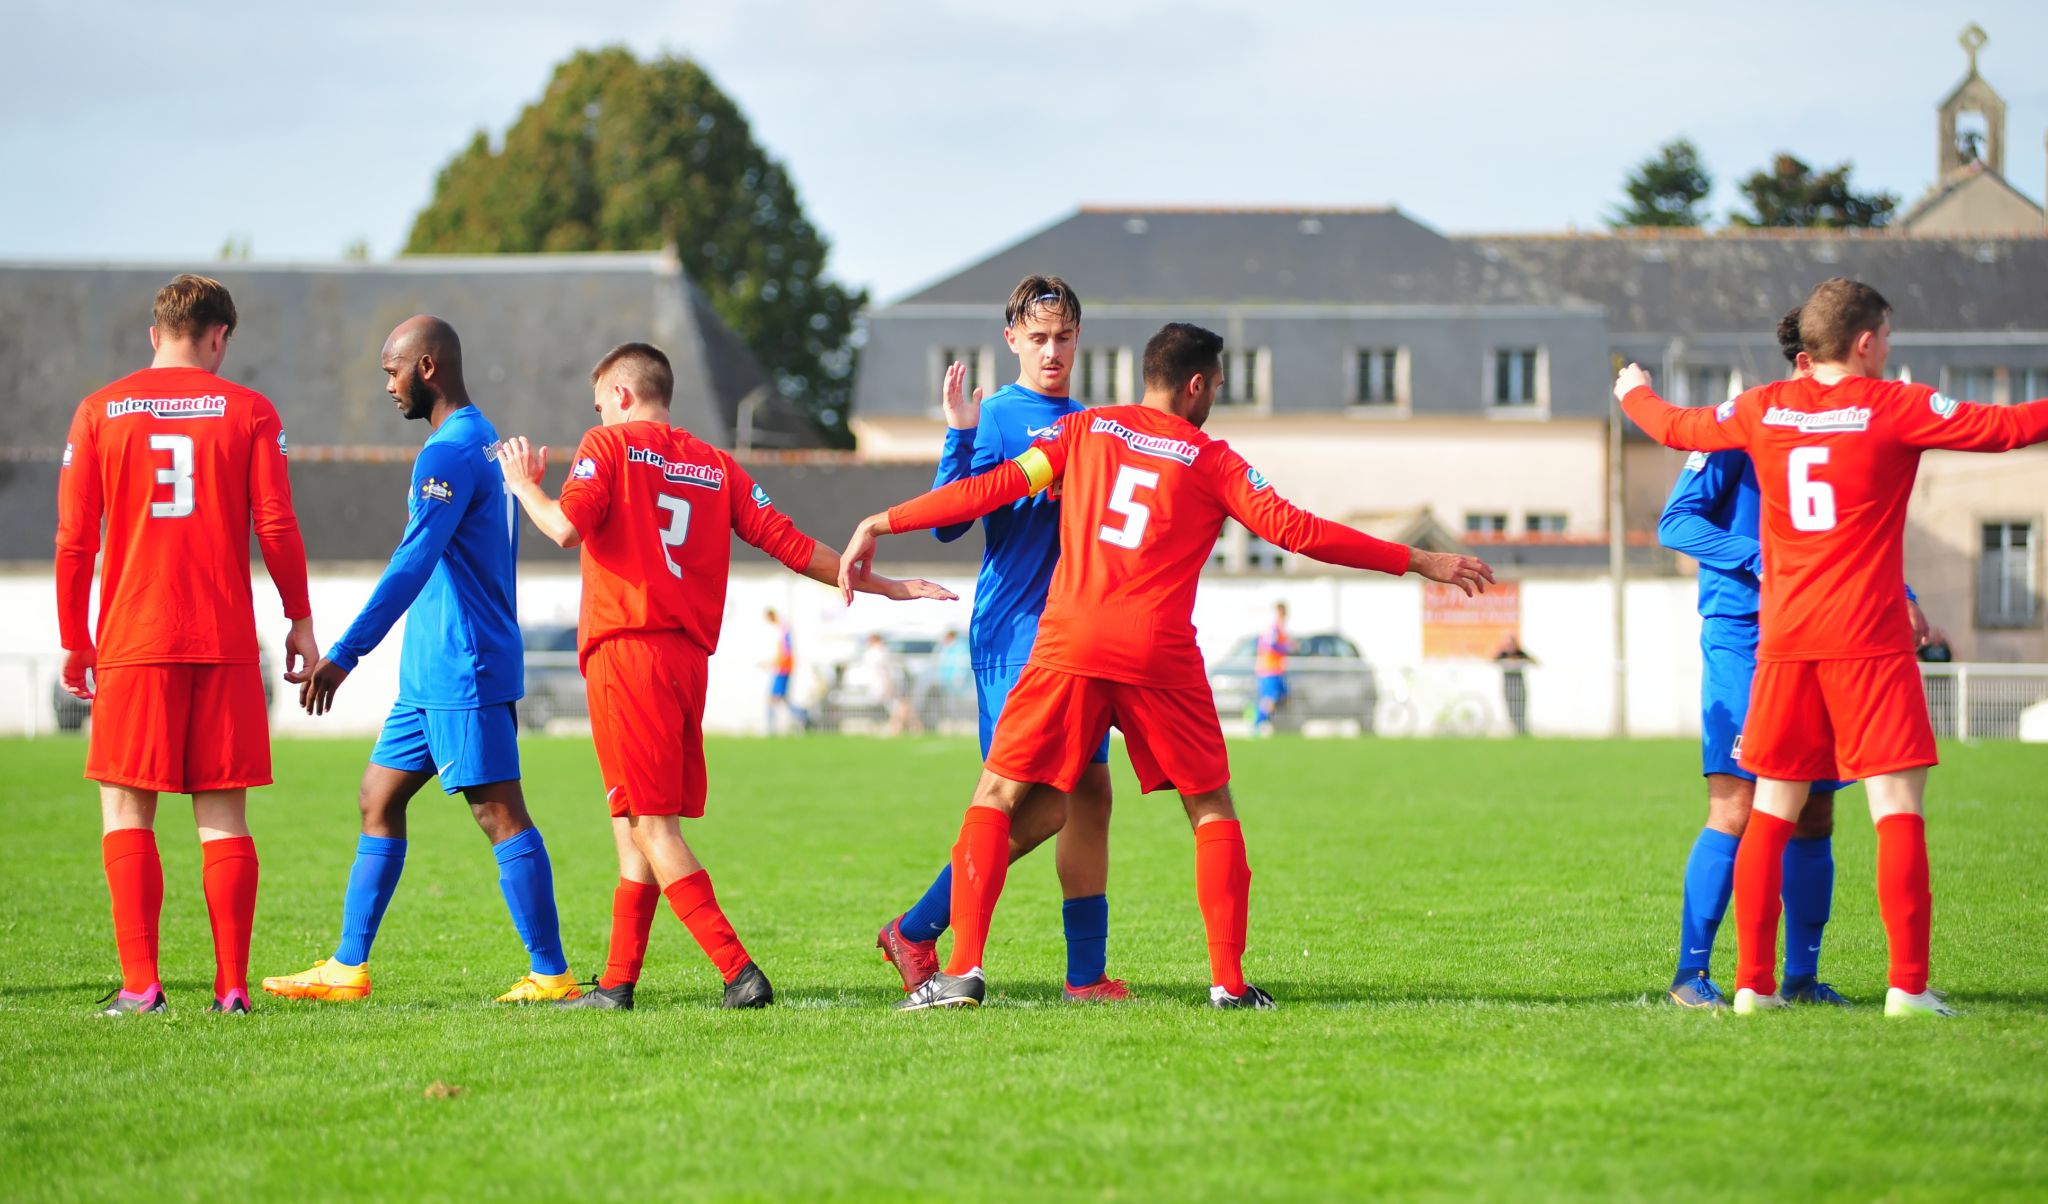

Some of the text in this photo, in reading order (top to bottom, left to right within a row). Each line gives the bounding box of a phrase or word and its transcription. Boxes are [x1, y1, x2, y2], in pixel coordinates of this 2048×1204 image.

[150, 434, 195, 517] 3
[1098, 463, 1160, 549] 5
[1788, 446, 1836, 532] 6
[657, 492, 692, 579] 2
